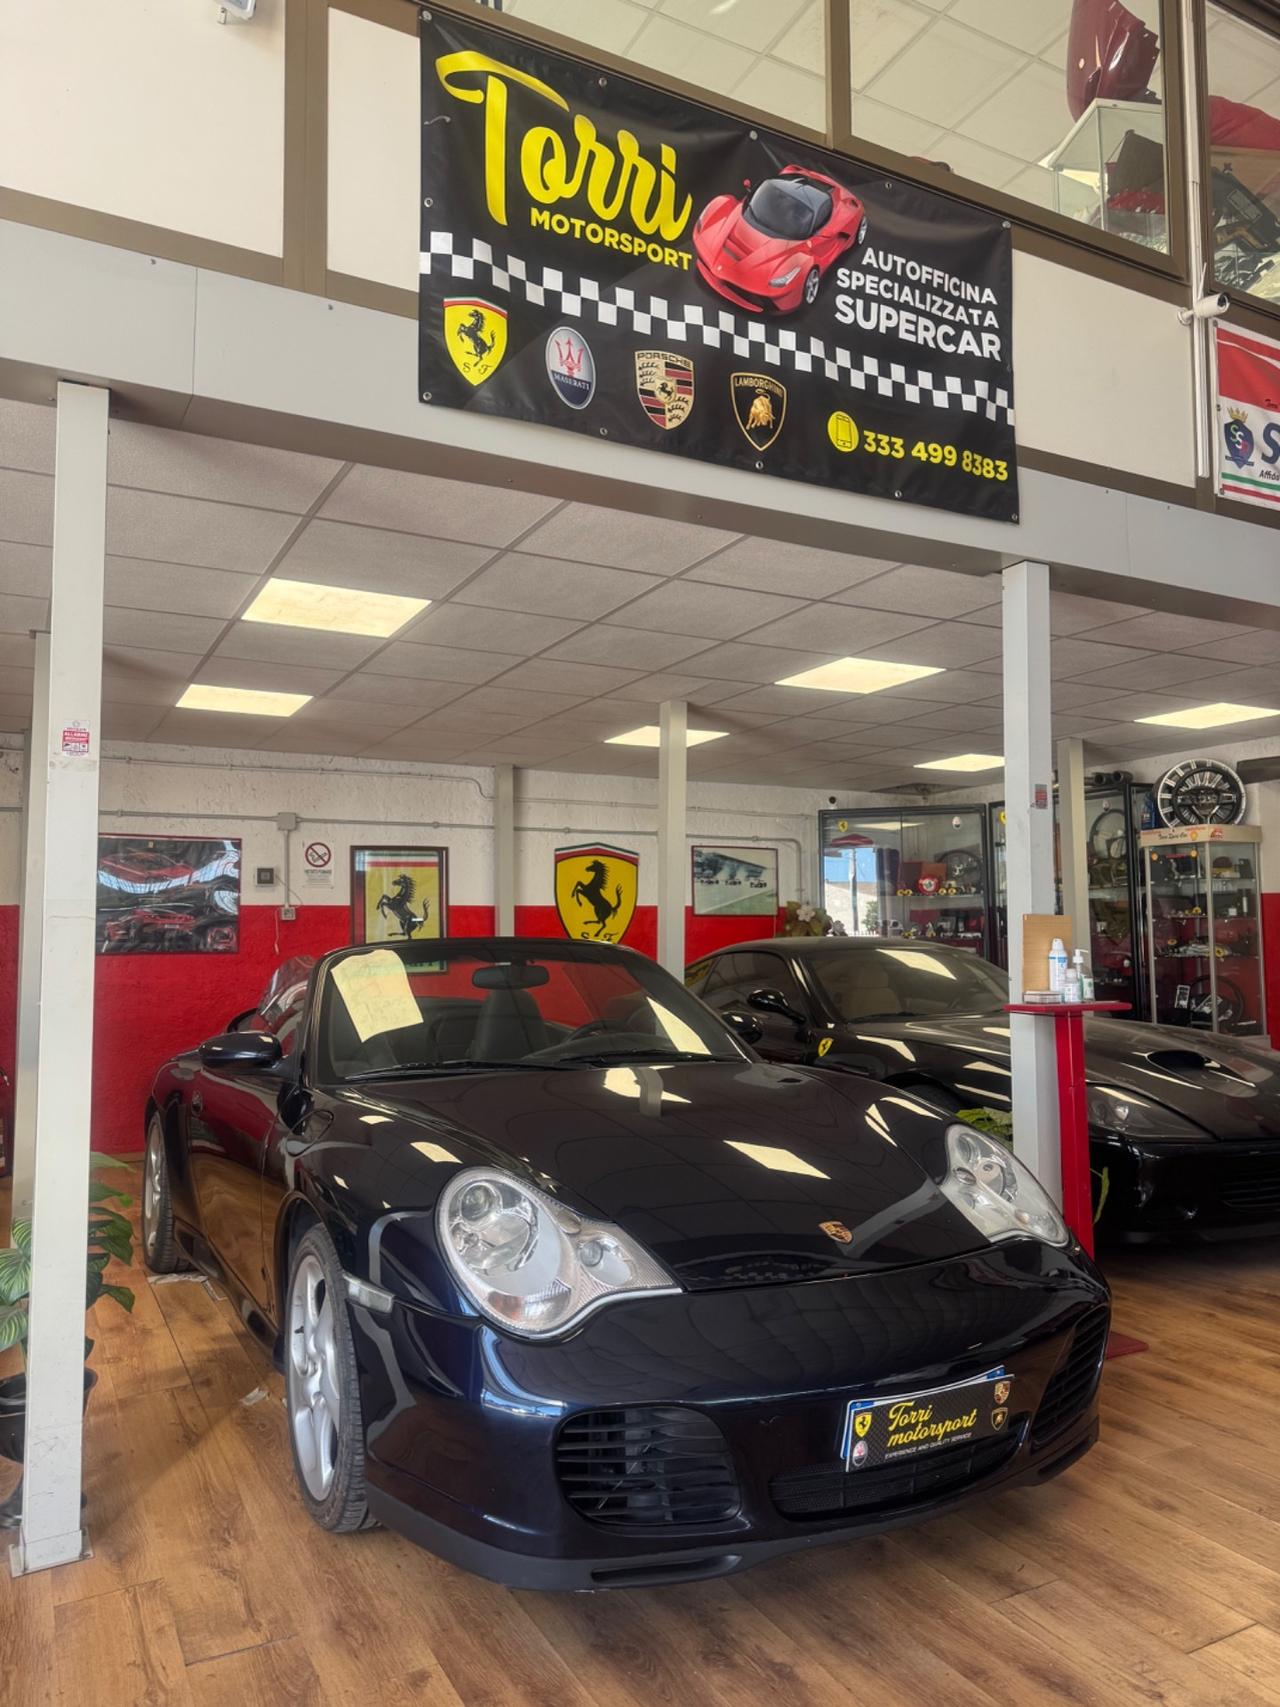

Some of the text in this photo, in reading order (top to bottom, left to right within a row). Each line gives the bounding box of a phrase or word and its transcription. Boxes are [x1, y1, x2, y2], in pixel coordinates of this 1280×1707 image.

[435, 50, 693, 242] Torri
[530, 207, 692, 271] MOTORSPORT
[836, 267, 1000, 329] SPECIALIZZATA
[861, 247, 998, 305] AUTOFFICINA
[834, 293, 1002, 362] SUPERCAR
[553, 373, 590, 390] MASERATI
[637, 352, 692, 369] PORSCHE
[863, 430, 1009, 482] 333 499 8383
[887, 1408, 978, 1447] motorsport
[888, 1401, 933, 1431] Torri
